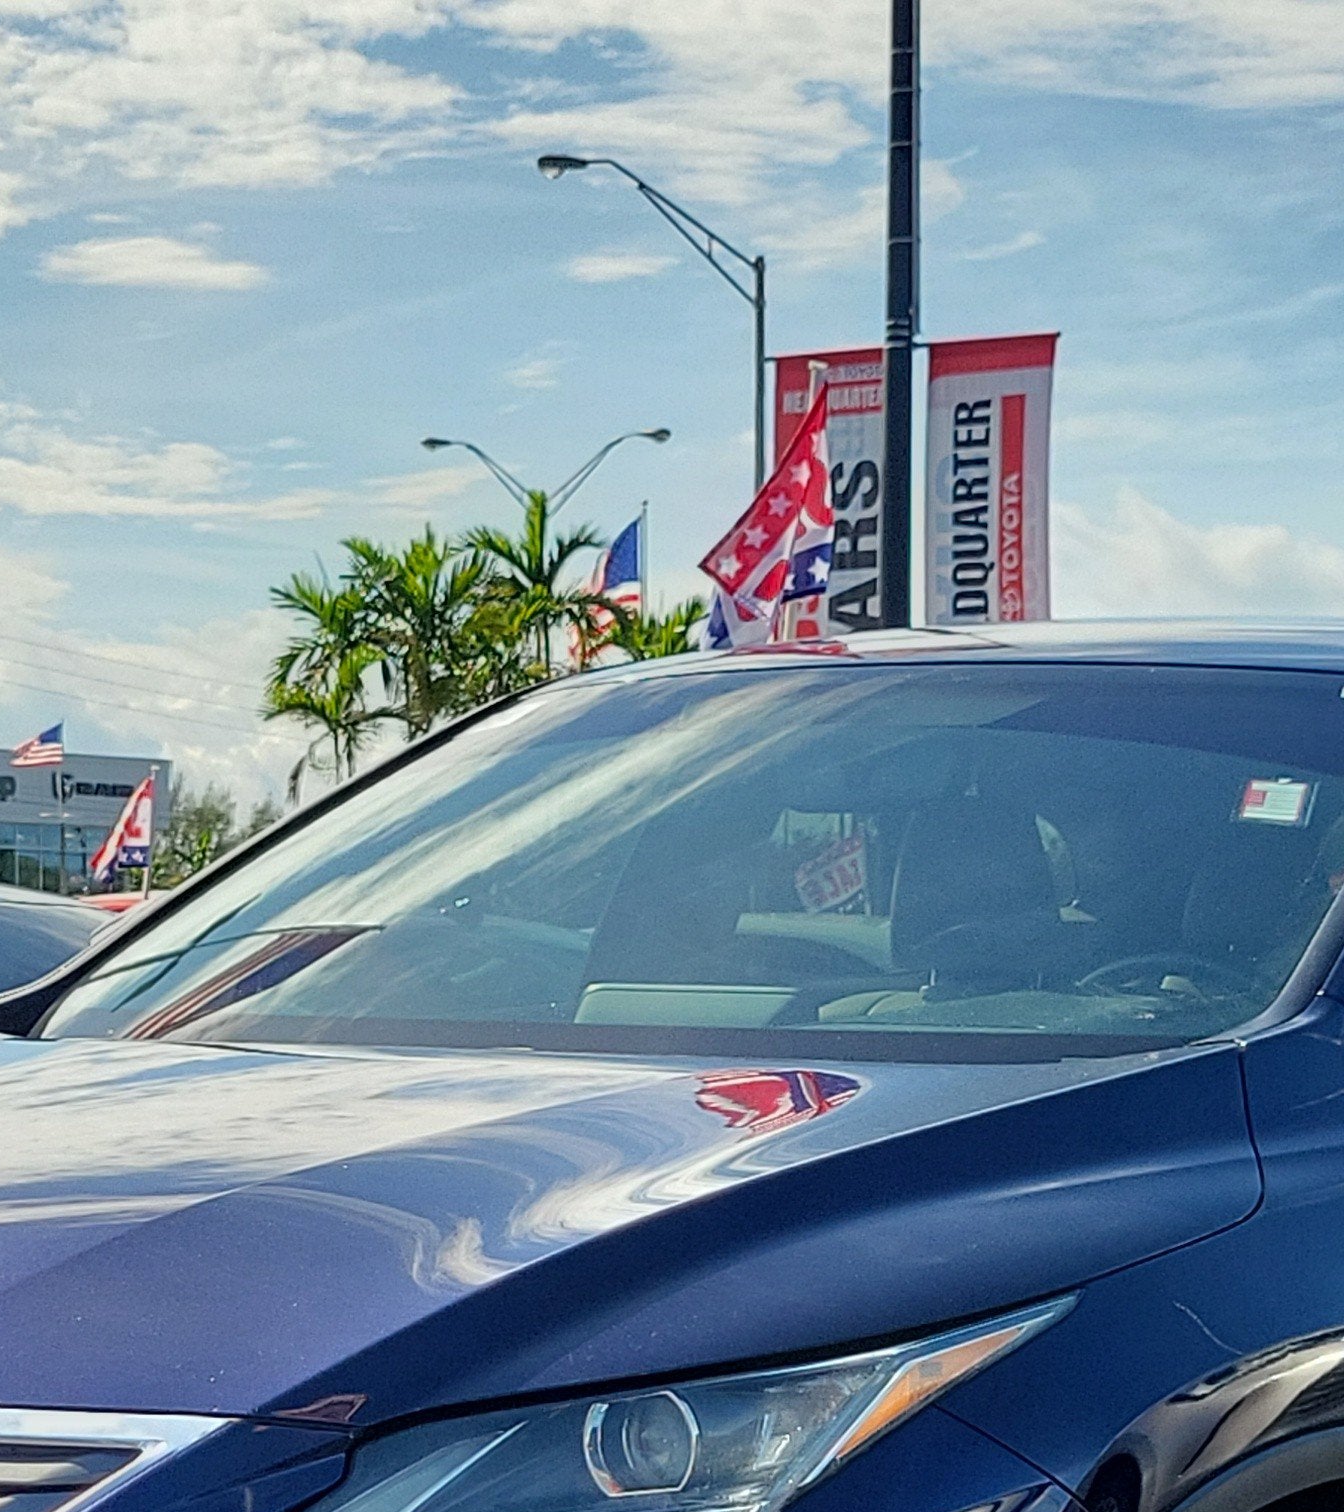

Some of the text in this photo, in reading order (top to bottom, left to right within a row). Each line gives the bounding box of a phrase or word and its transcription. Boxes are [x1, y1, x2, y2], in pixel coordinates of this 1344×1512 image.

[828, 460, 882, 632] ARS
[951, 398, 994, 618] DQUARTER
[1001, 471, 1021, 588] TOYOTA
